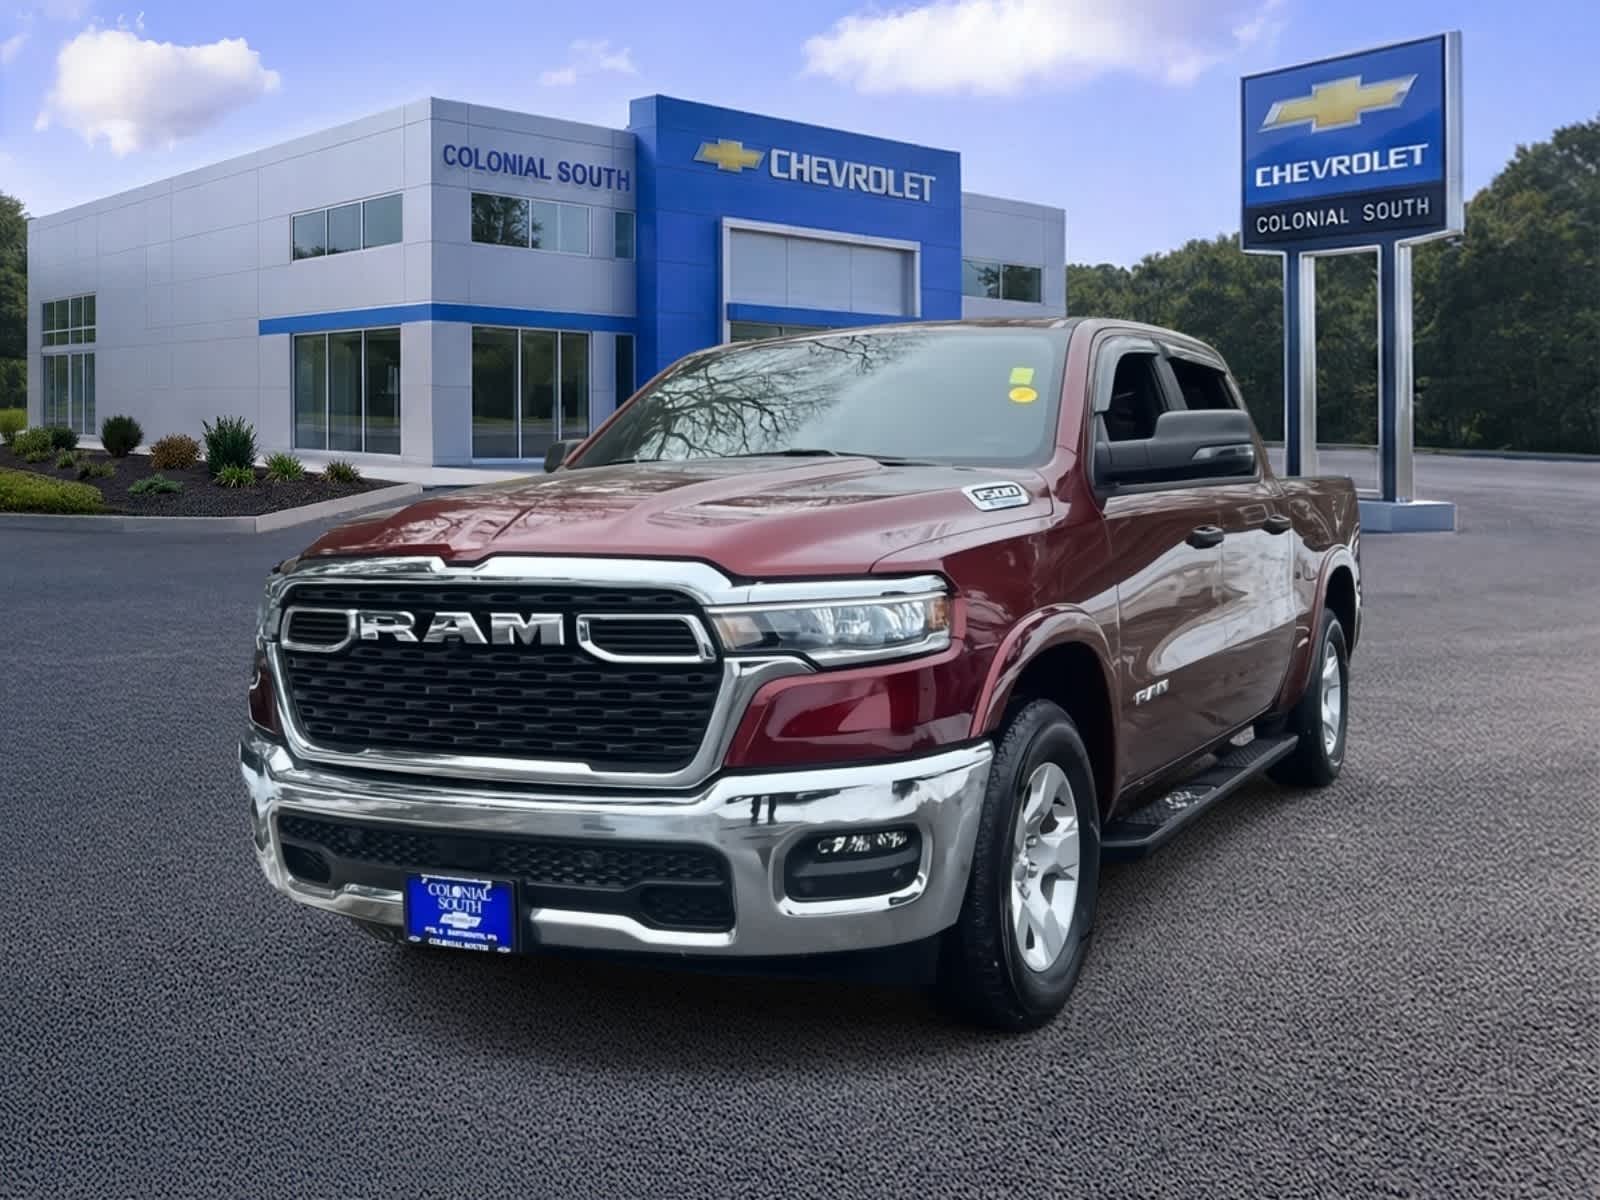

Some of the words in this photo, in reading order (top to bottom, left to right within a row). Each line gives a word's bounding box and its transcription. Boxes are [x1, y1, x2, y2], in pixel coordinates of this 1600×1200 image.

[443, 144, 552, 180] COLONIAL
[557, 161, 630, 191] SOUTH
[770, 148, 936, 202] CHEVROLET
[1255, 143, 1429, 187] CHEVROLET
[1256, 208, 1350, 233] COLONIAL
[1363, 197, 1429, 221] SOUTH
[360, 609, 564, 645] RAM
[428, 882, 492, 901] COLONIAL
[438, 897, 482, 914] SOUTH
